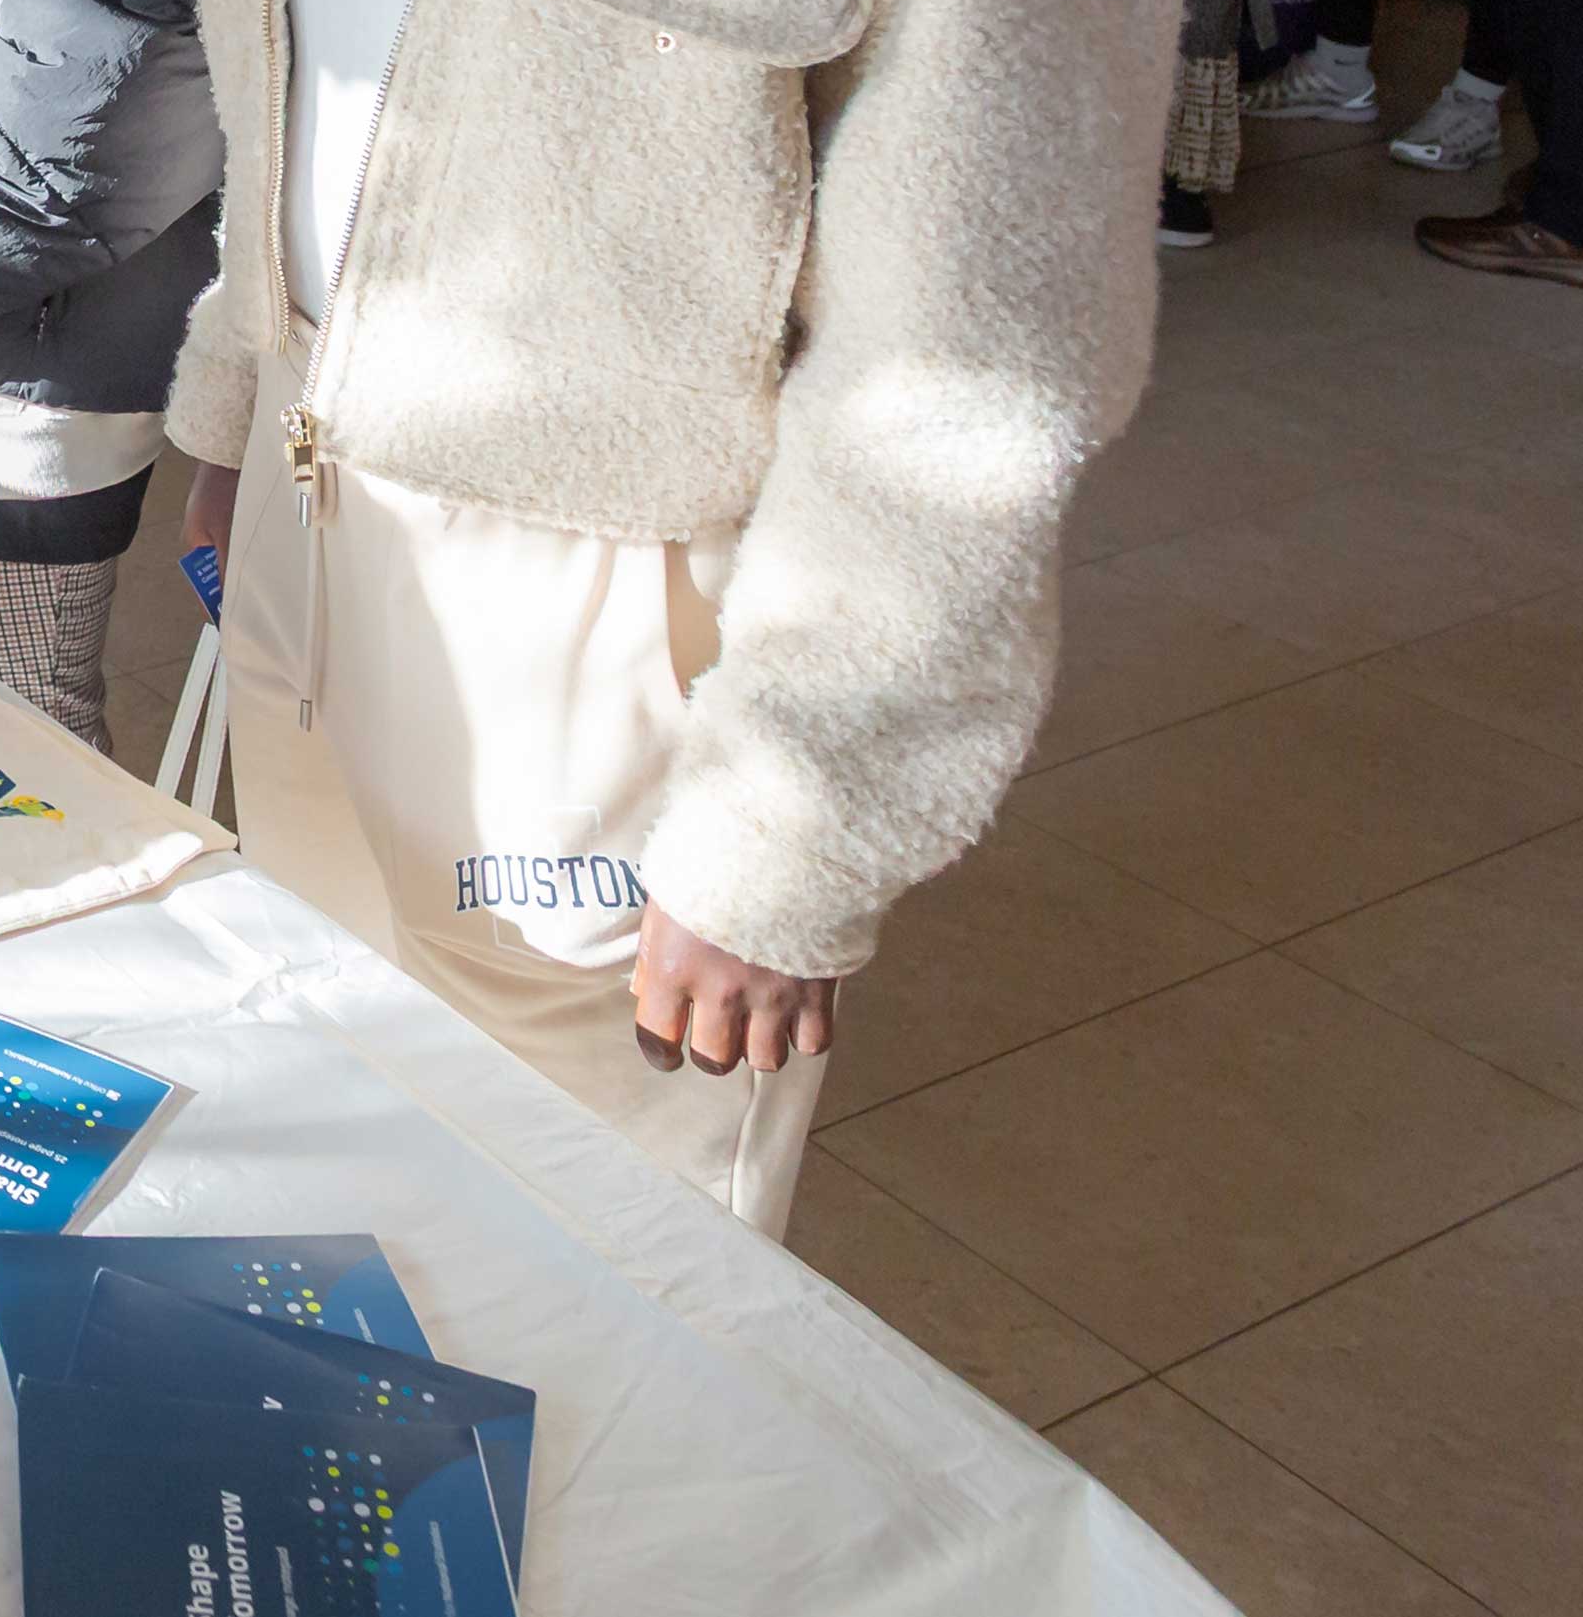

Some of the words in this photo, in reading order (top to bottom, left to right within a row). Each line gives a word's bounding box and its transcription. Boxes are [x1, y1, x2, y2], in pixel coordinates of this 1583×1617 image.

[455, 854, 648, 912] HOUSTON
[27, 1141, 55, 1158] page
[219, 1489, 255, 1617] omorrow
